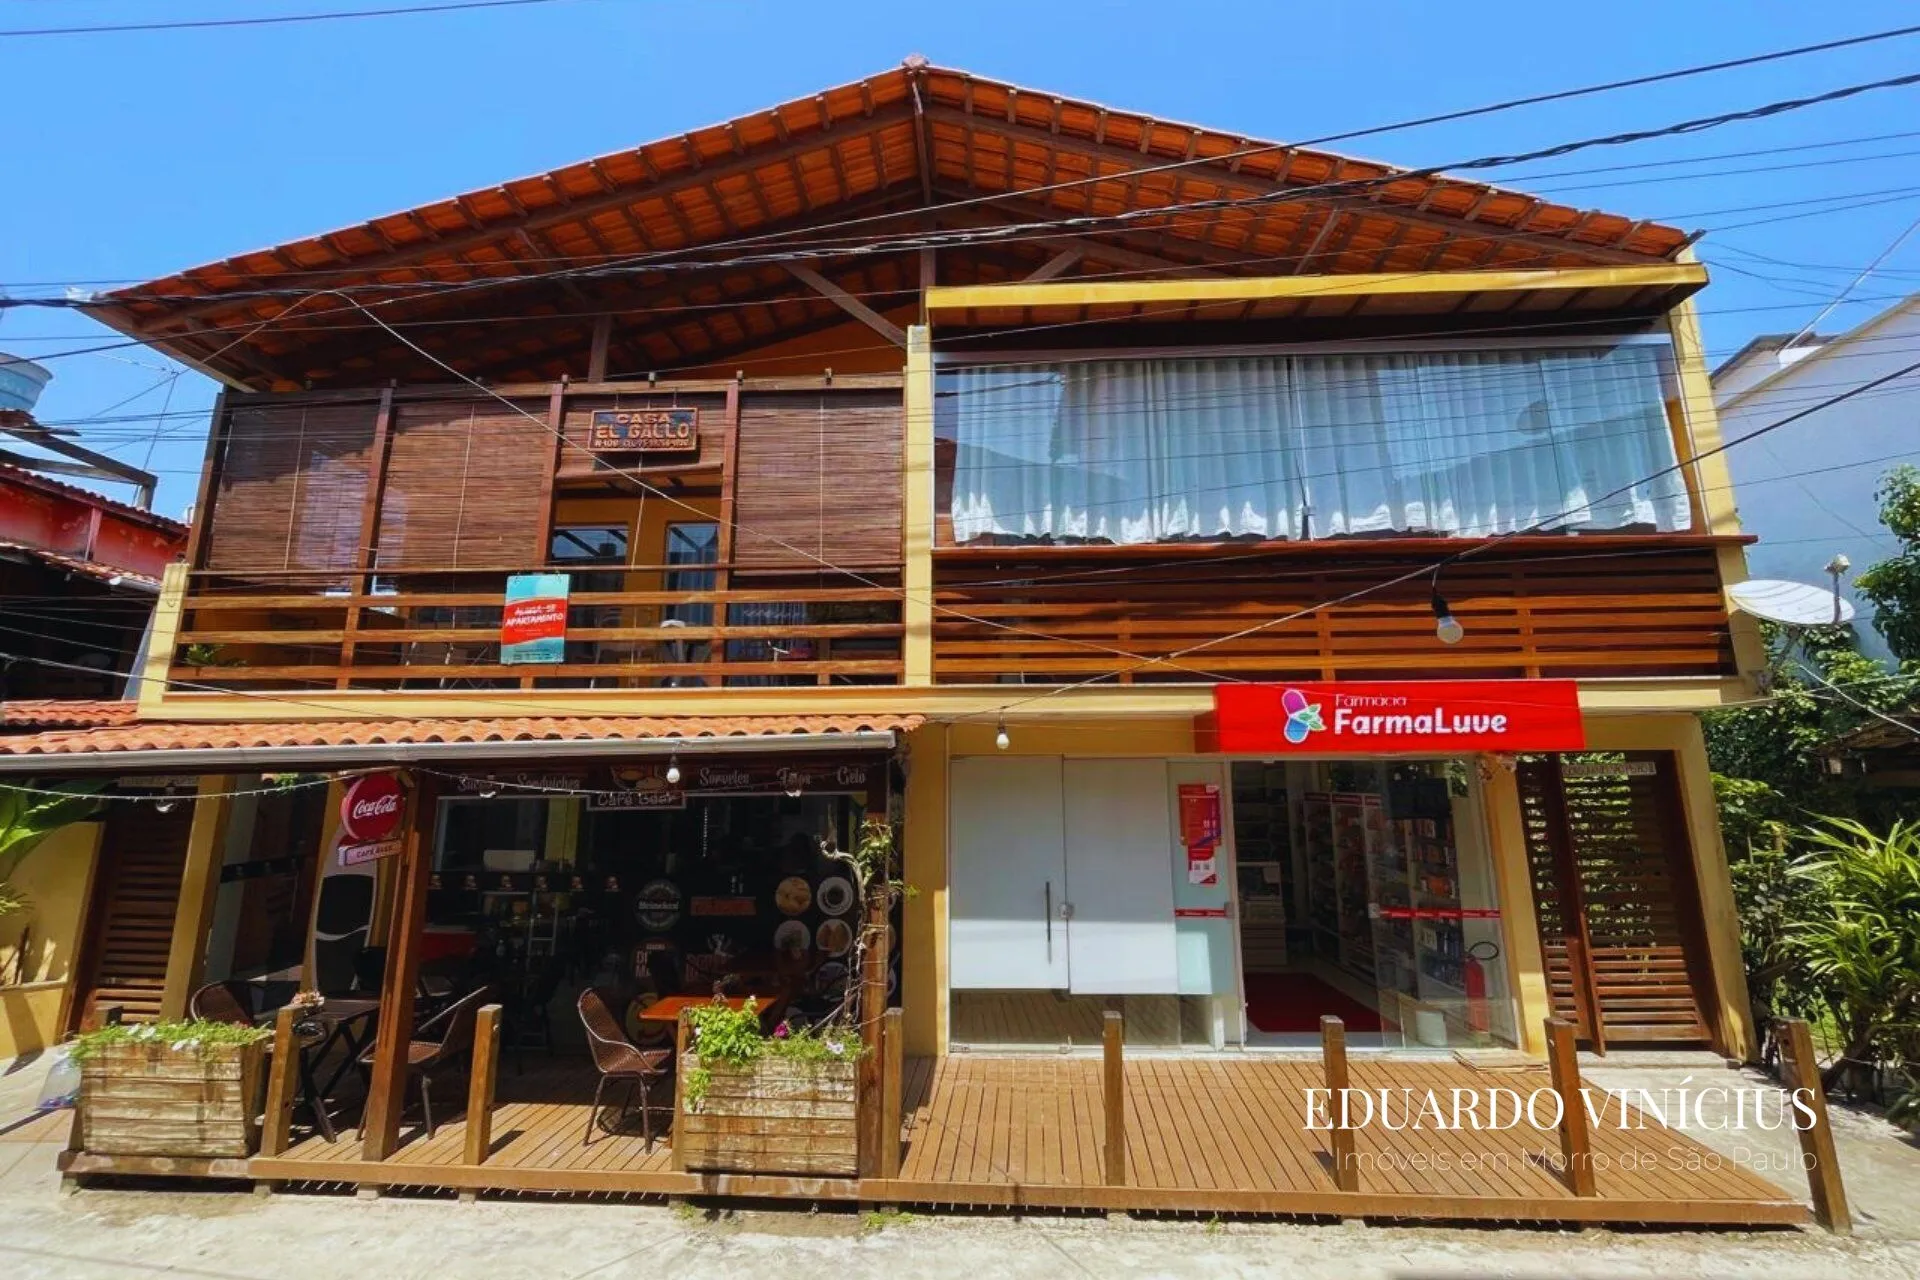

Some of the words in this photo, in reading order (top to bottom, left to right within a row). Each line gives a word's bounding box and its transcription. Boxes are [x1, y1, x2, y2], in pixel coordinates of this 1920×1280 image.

[615, 413, 672, 424] CASA
[596, 424, 620, 438] EL
[628, 422, 690, 439] GALLO
[505, 613, 564, 627] APARTAMENTO
[1334, 707, 1507, 735] FarmaLuve
[836, 765, 867, 786] Gelo
[352, 794, 398, 819] Coca-Cola
